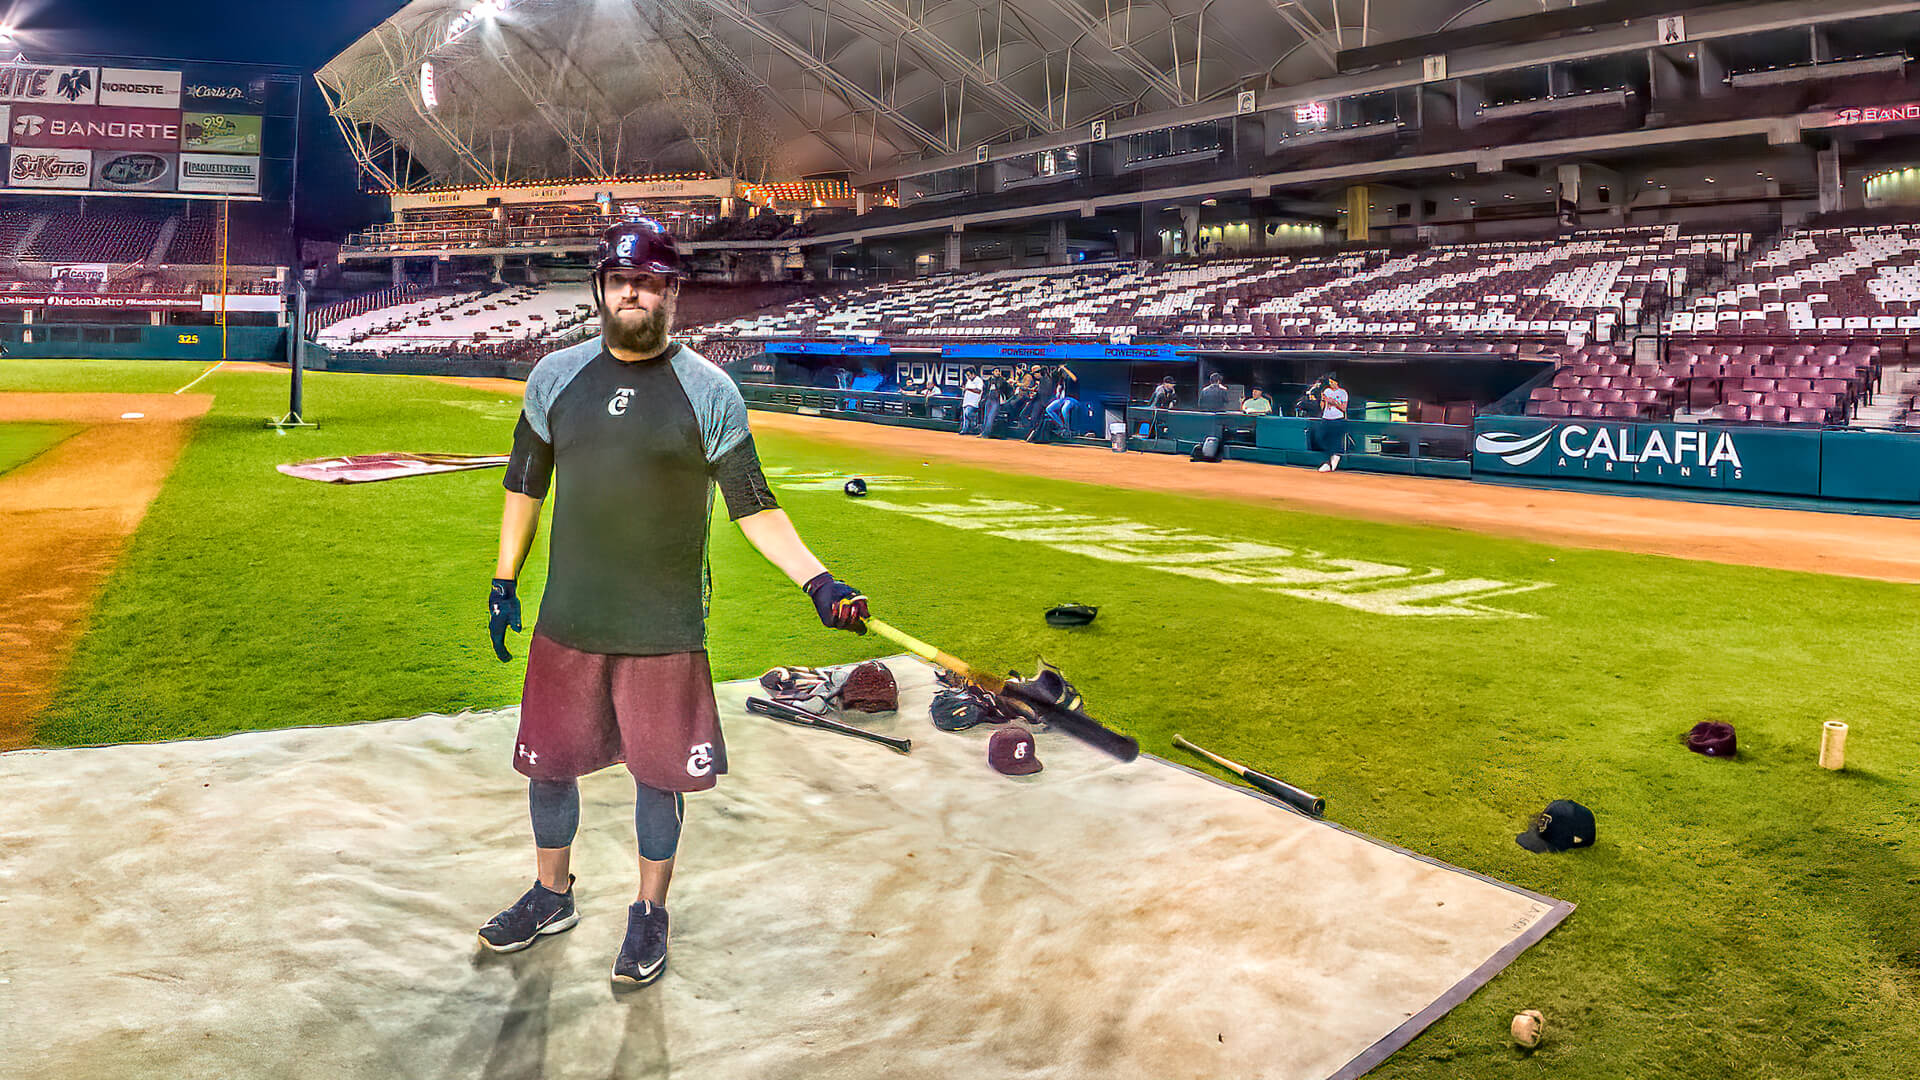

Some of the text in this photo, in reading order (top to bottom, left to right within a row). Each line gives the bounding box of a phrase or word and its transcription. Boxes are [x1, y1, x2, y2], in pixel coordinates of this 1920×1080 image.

[102, 82, 163, 95] NOROESTE
[50, 120, 178, 139] BANORTE
[177, 334, 199, 344] 325
[1559, 425, 1741, 468] CALAFIA
[1558, 458, 1743, 480] AIRLINES
